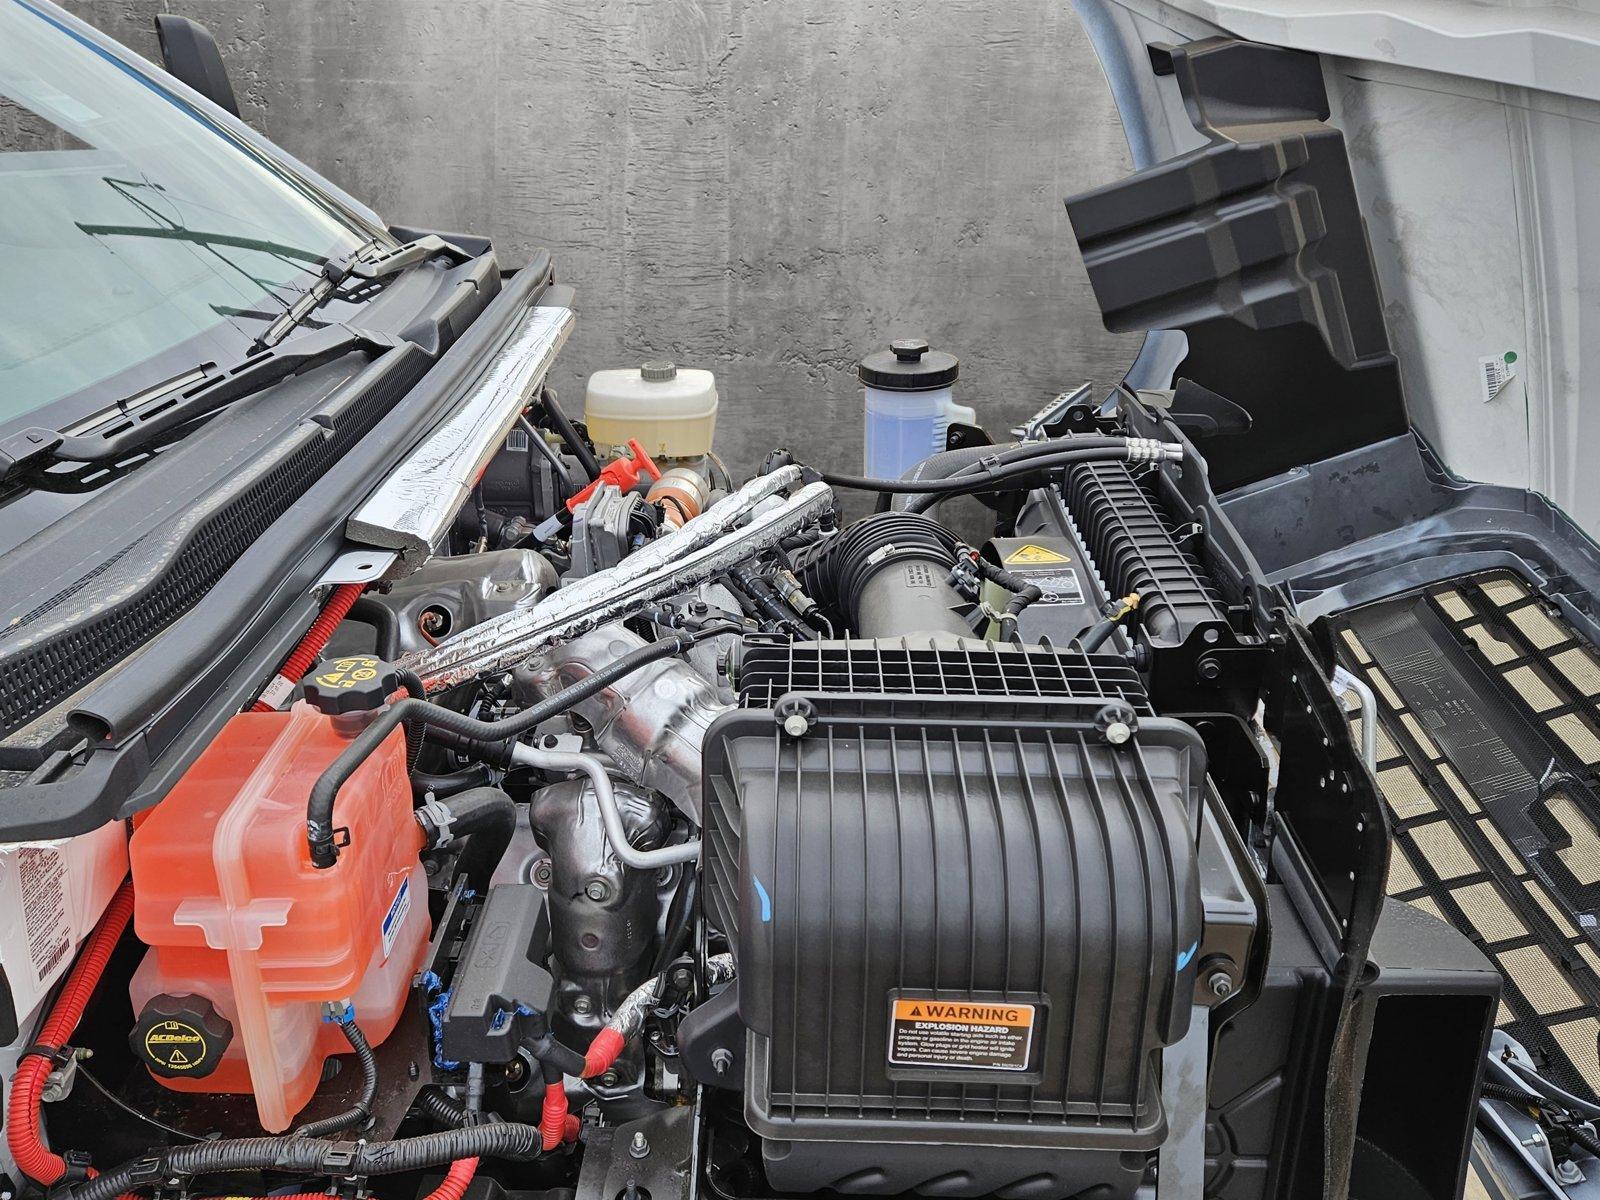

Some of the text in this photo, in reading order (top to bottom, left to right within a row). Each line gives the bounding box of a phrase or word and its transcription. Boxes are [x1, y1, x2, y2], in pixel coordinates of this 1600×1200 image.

[927, 1006, 1018, 1022] WARNING
[915, 1022, 1009, 1034] EXPLOSION HAZARD
[150, 1034, 200, 1042] ACDelco
